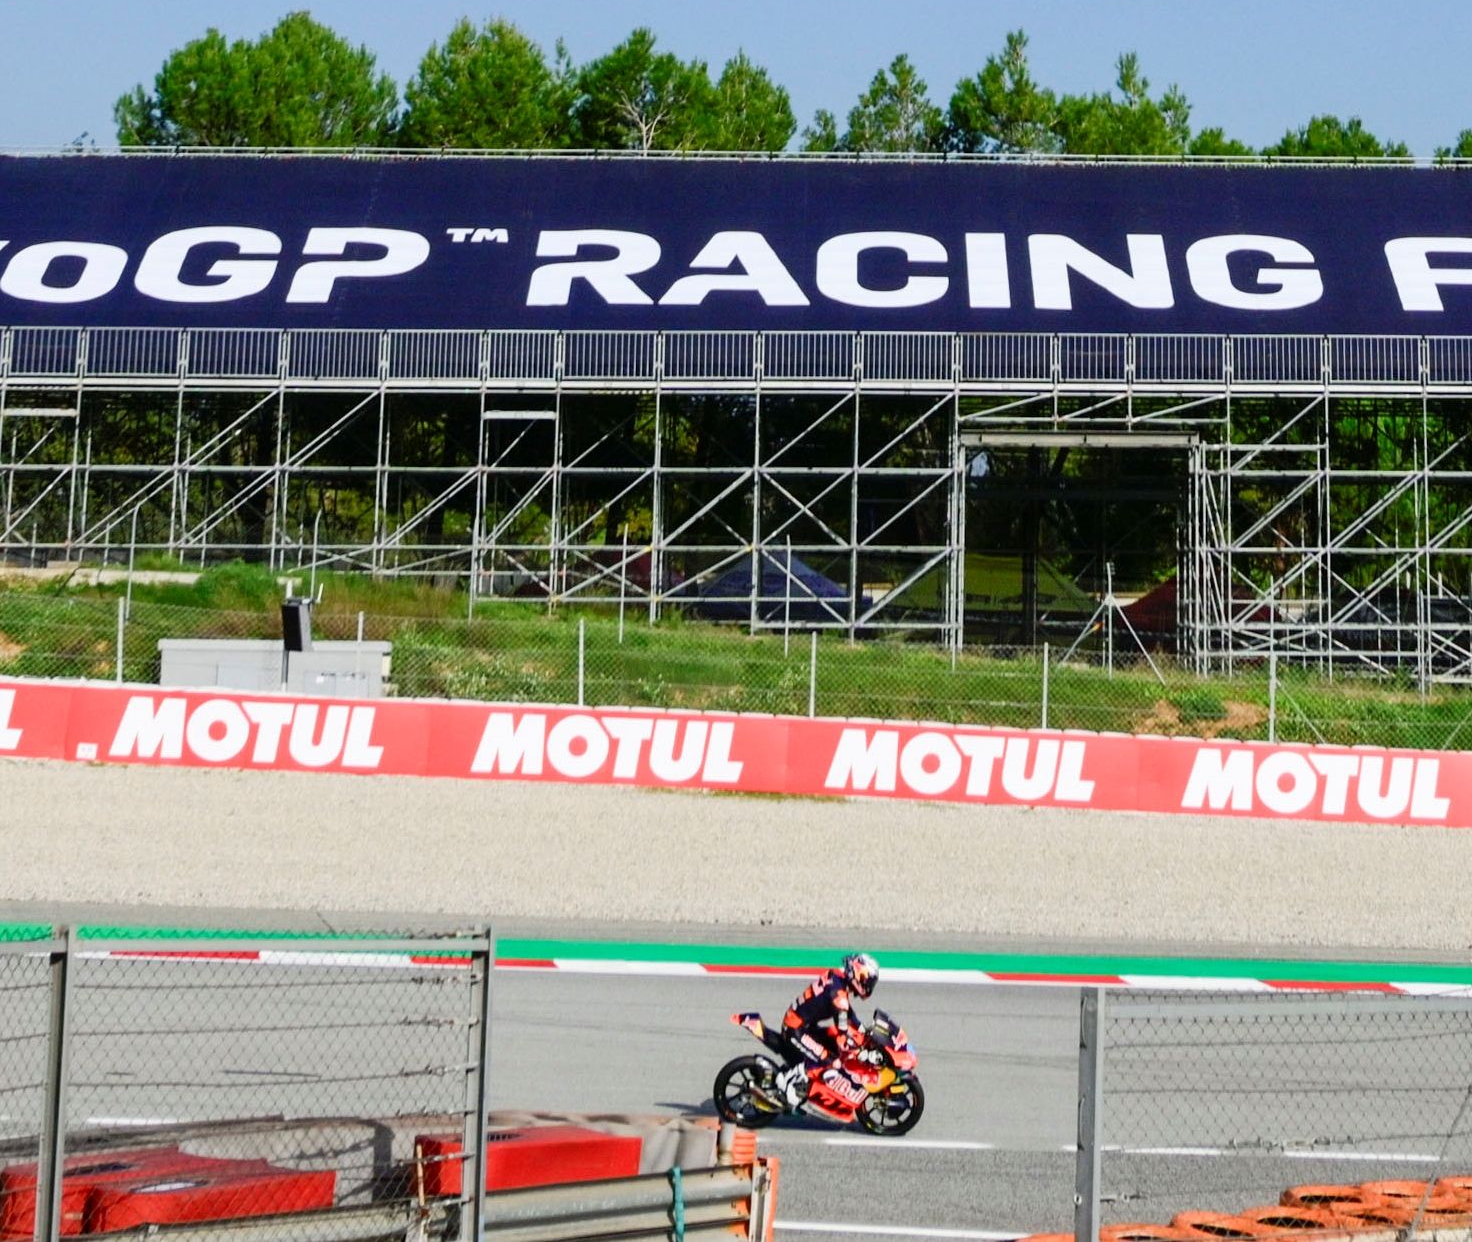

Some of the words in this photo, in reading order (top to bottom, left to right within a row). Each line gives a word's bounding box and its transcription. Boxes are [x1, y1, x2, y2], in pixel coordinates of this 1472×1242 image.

[525, 229, 1324, 311] RACING
[108, 696, 385, 768] MOTUL
[470, 712, 744, 783] MOTUL
[823, 728, 1096, 802] MOTUL
[1181, 747, 1450, 820] MOTUL
